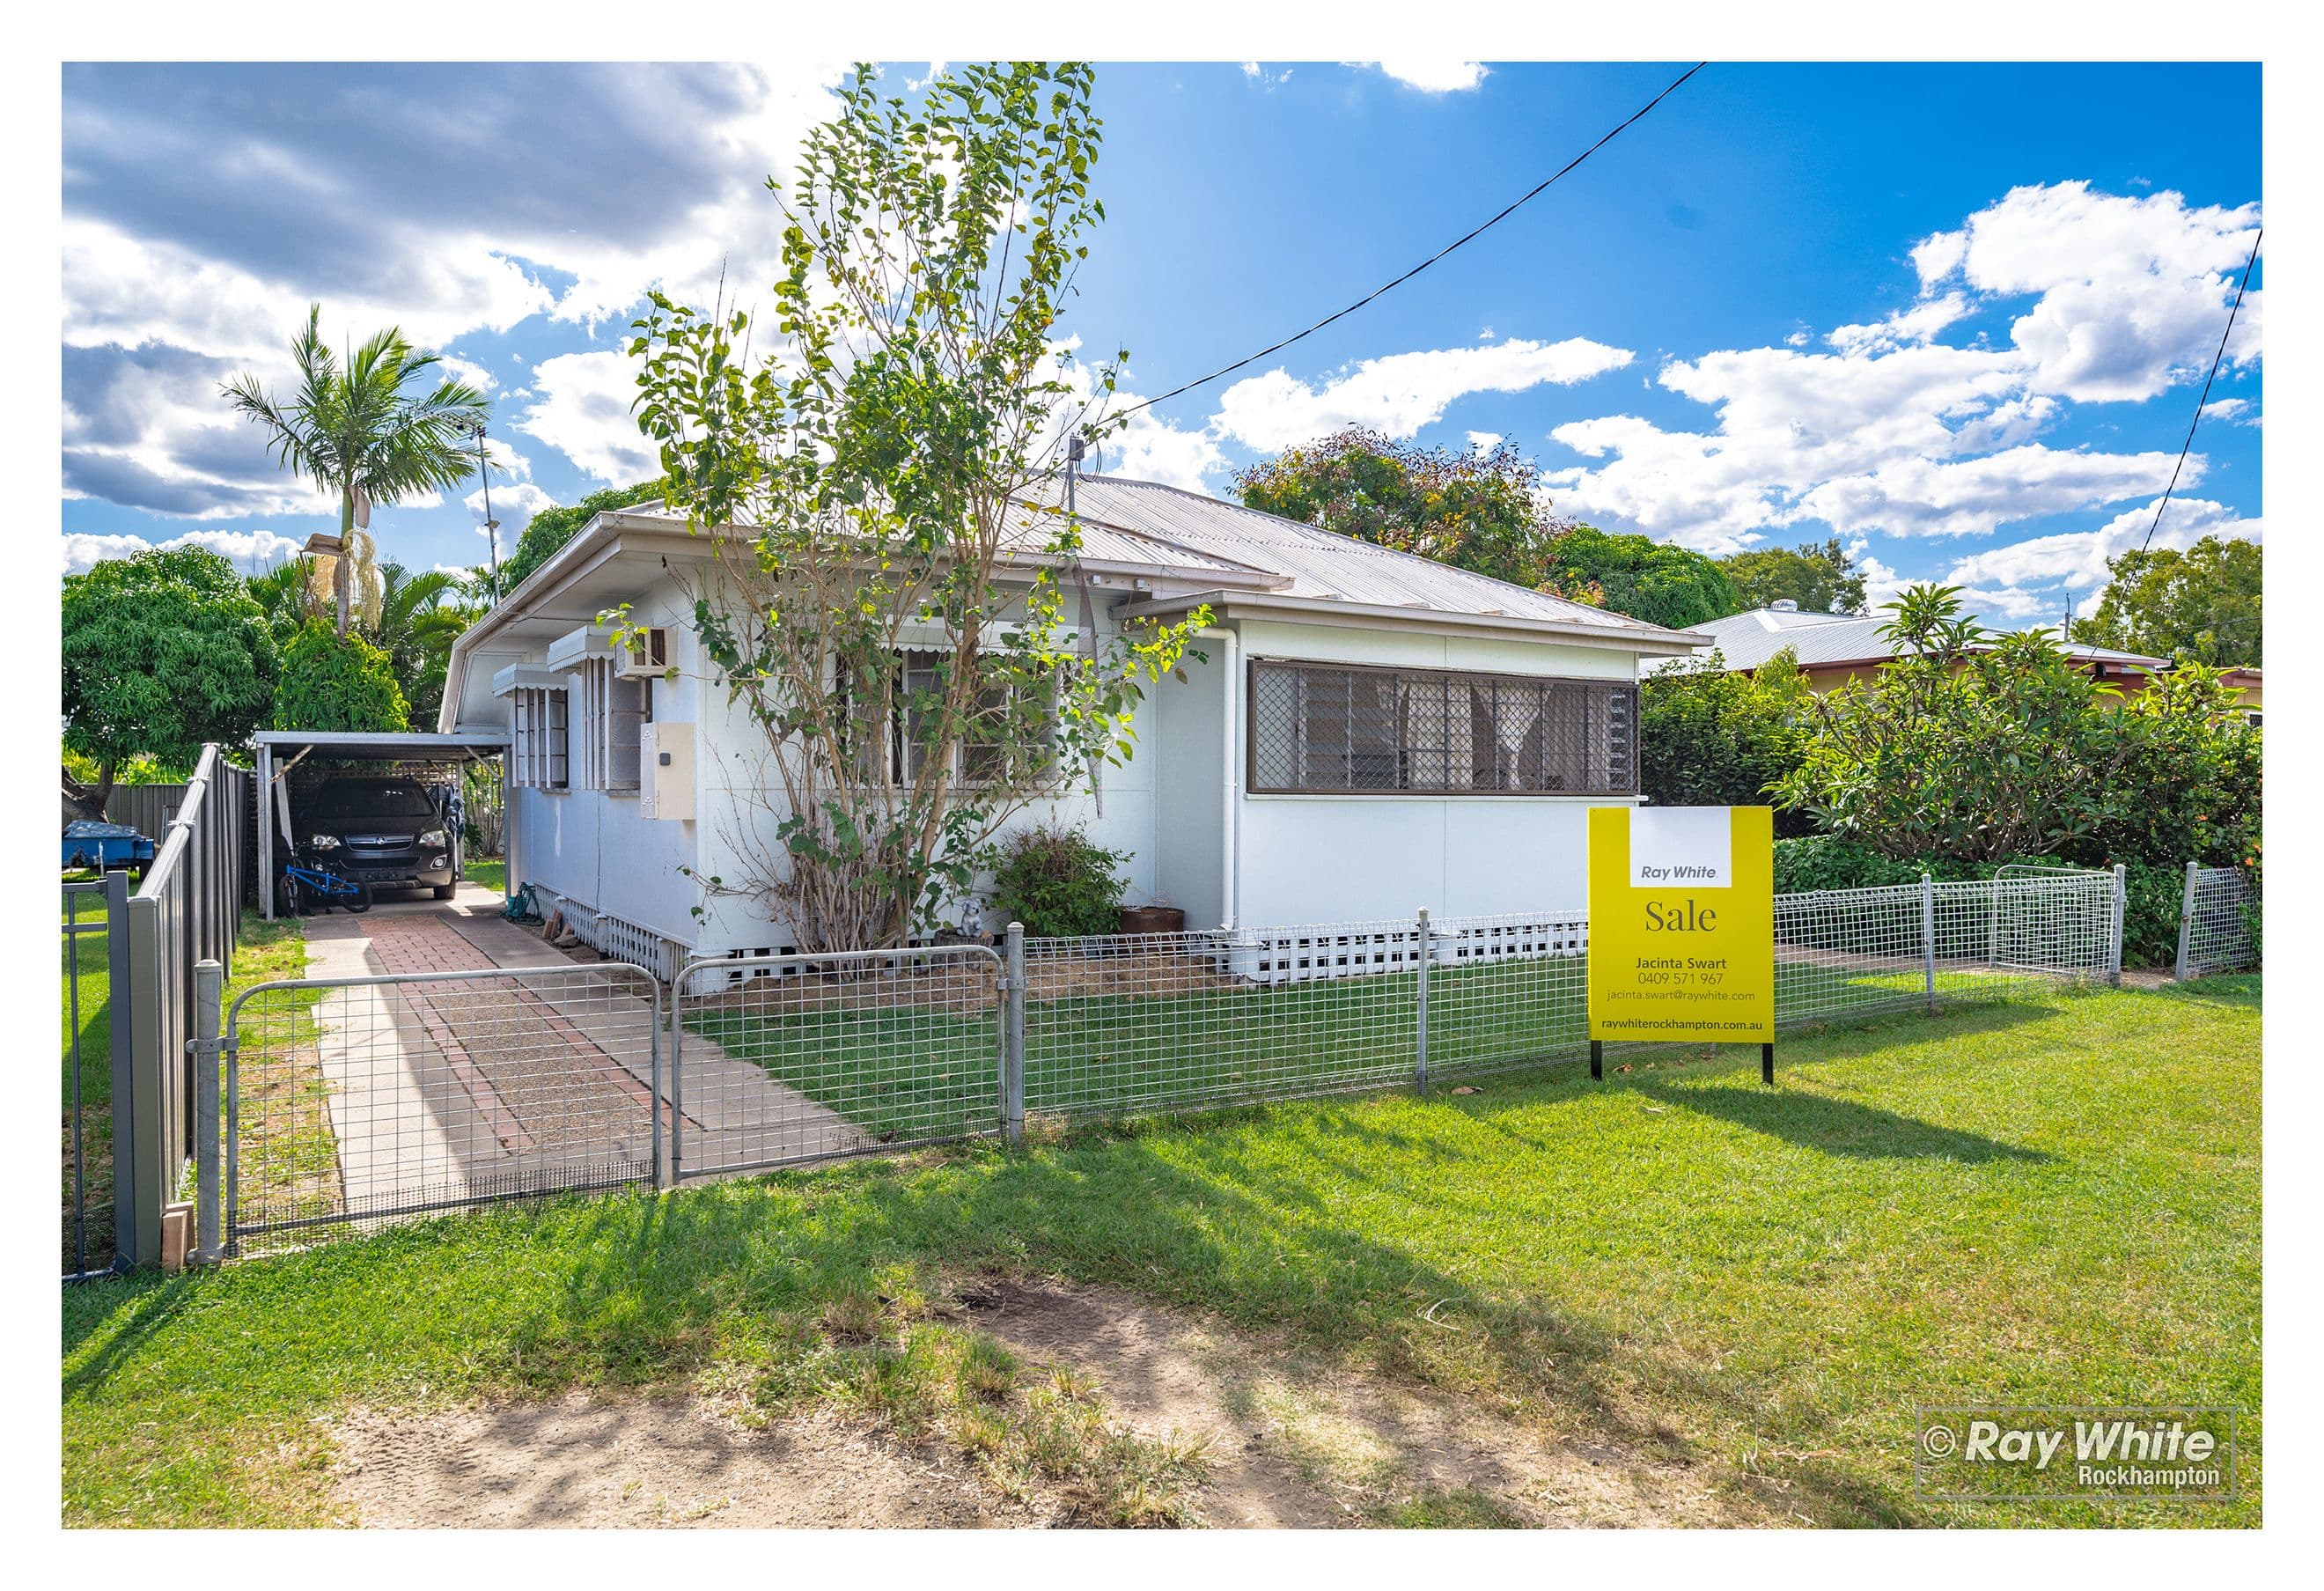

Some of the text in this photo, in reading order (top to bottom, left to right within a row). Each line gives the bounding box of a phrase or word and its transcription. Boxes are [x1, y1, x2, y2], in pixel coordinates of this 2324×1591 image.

[1641, 865, 1717, 881] Ray White
[1645, 899, 1717, 932] Sale
[1636, 957, 1727, 969] Jacinta Swart
[1637, 972, 1723, 985] 0409 571 967
[1606, 990, 1755, 1002] jacinta.swart@raywhite.com
[1601, 1019, 1762, 1031] raywhiterockhampton.com.au
